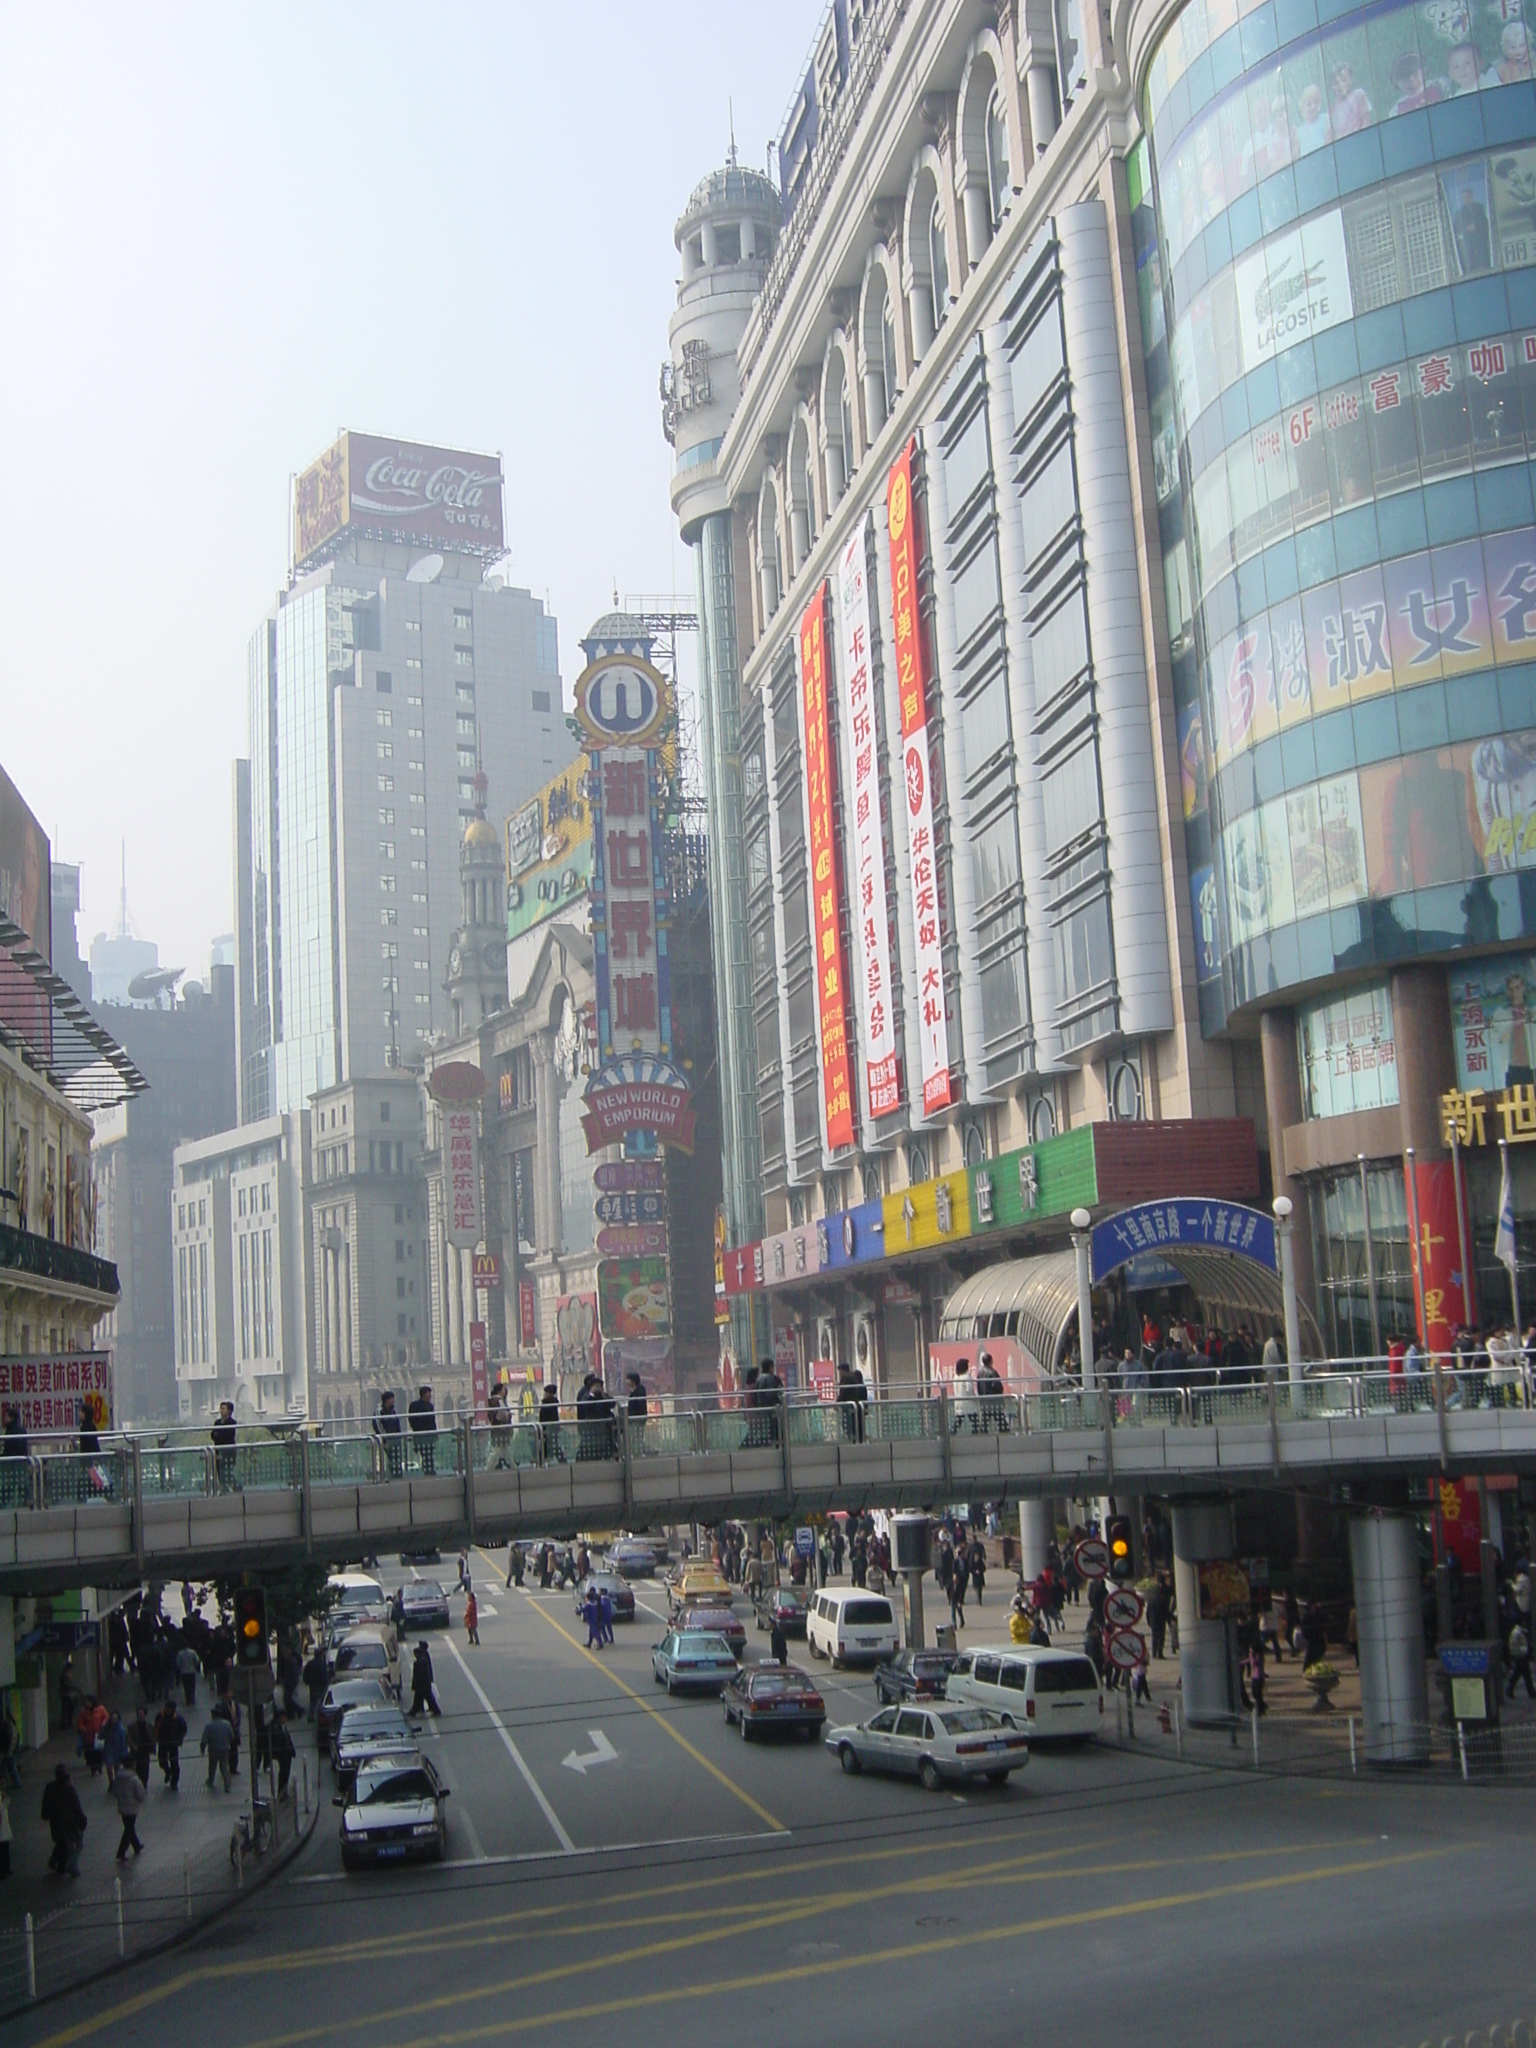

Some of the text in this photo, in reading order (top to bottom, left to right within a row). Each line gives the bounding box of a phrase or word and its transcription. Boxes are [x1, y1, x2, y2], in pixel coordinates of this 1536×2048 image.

[1504, 240, 1536, 265] 丽
[1258, 297, 1330, 350] LACOSTE
[1255, 430, 1280, 465] Coffee
[1290, 406, 1314, 446] 6F
[1324, 392, 1359, 429] Coffee
[365, 456, 484, 507] Coca-Cola
[895, 540, 919, 730] TCL美之声
[603, 760, 657, 1031] 新世界城
[911, 826, 938, 950] 华伦天奴
[1462, 982, 1487, 1073] 上海永新
[1334, 1041, 1395, 1077] 上海品牌
[596, 1089, 680, 1111] NEW WORLD
[603, 1108, 676, 1127] EMPORIUM
[1442, 1084, 1536, 1147] 新世
[449, 1114, 477, 1230] 华威娱乐总汇
[1113, 1206, 1258, 1251] 十里南京路 一个新世界
[0, 1360, 107, 1394] 全棉免烫休闲系列
